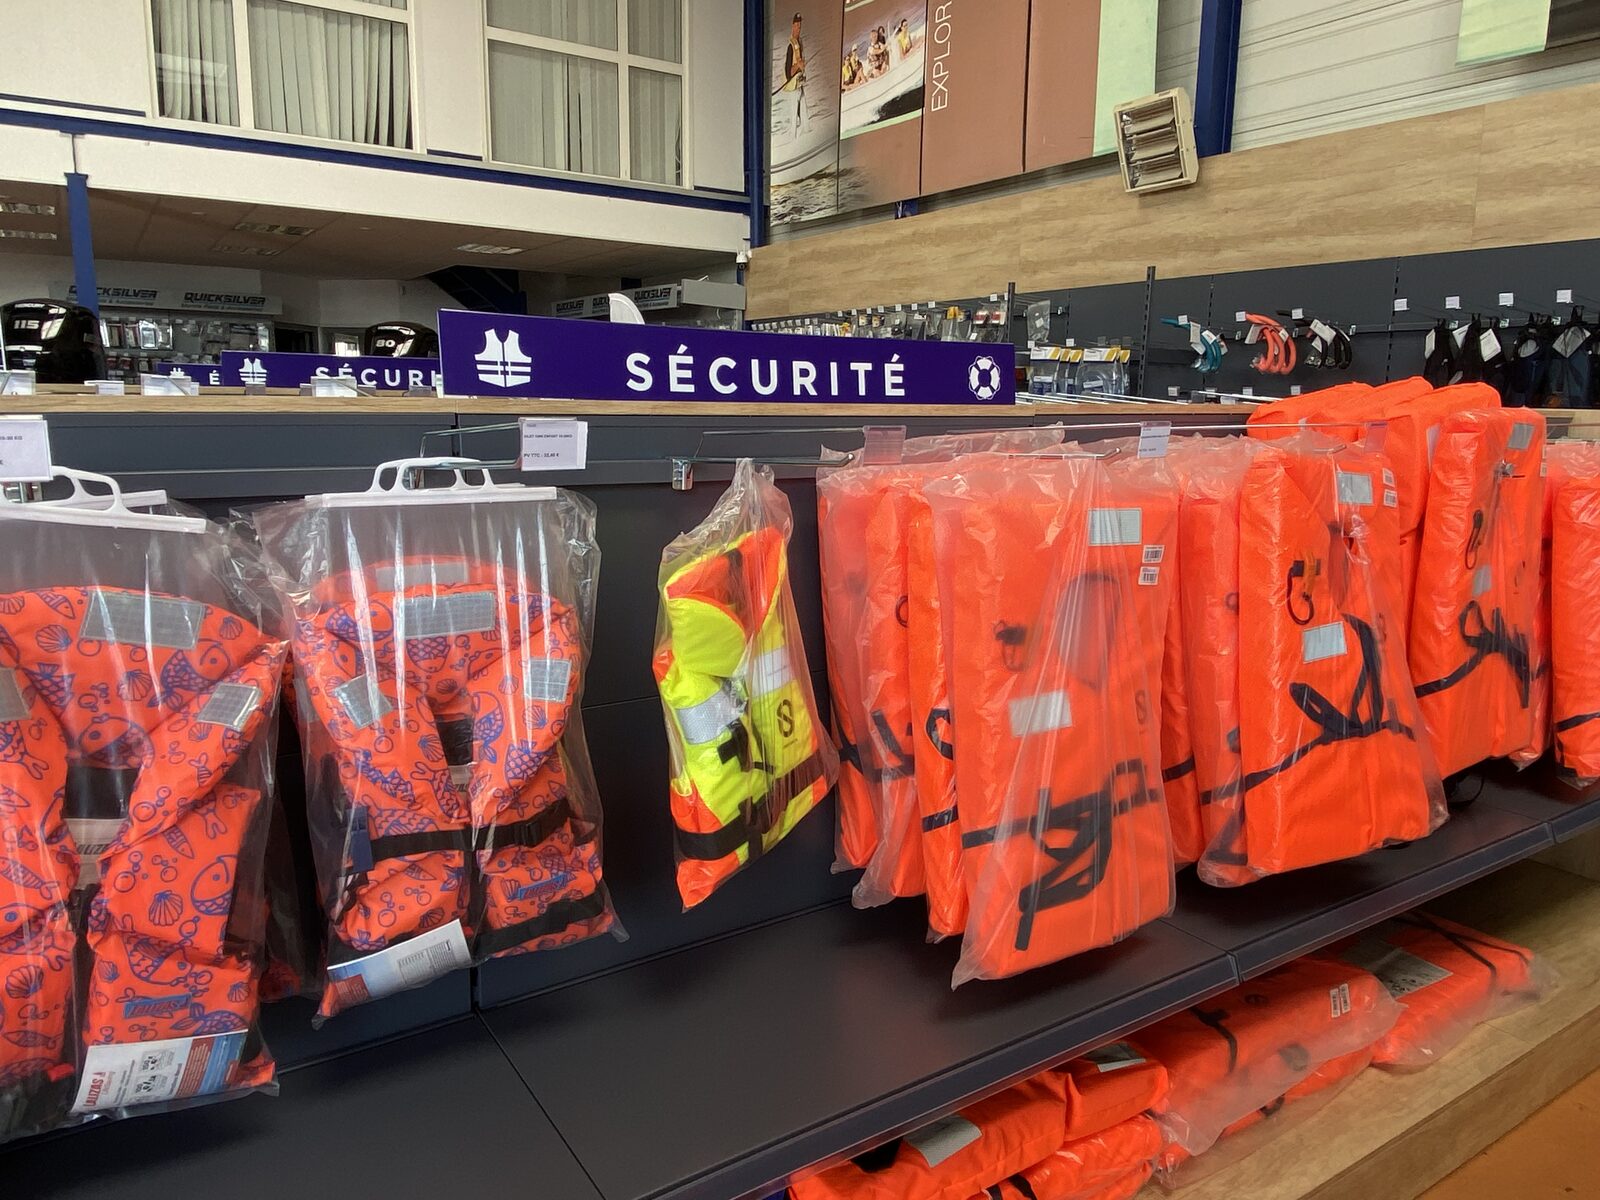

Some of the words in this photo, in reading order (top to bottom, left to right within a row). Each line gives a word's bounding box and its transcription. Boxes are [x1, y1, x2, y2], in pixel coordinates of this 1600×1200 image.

[931, 0, 953, 112] EXPLOR
[68, 285, 158, 298] QCKSILVER
[184, 292, 266, 305] QUICKSILVER
[14, 319, 40, 330] 115
[626, 343, 906, 397] SÉCURITÉ
